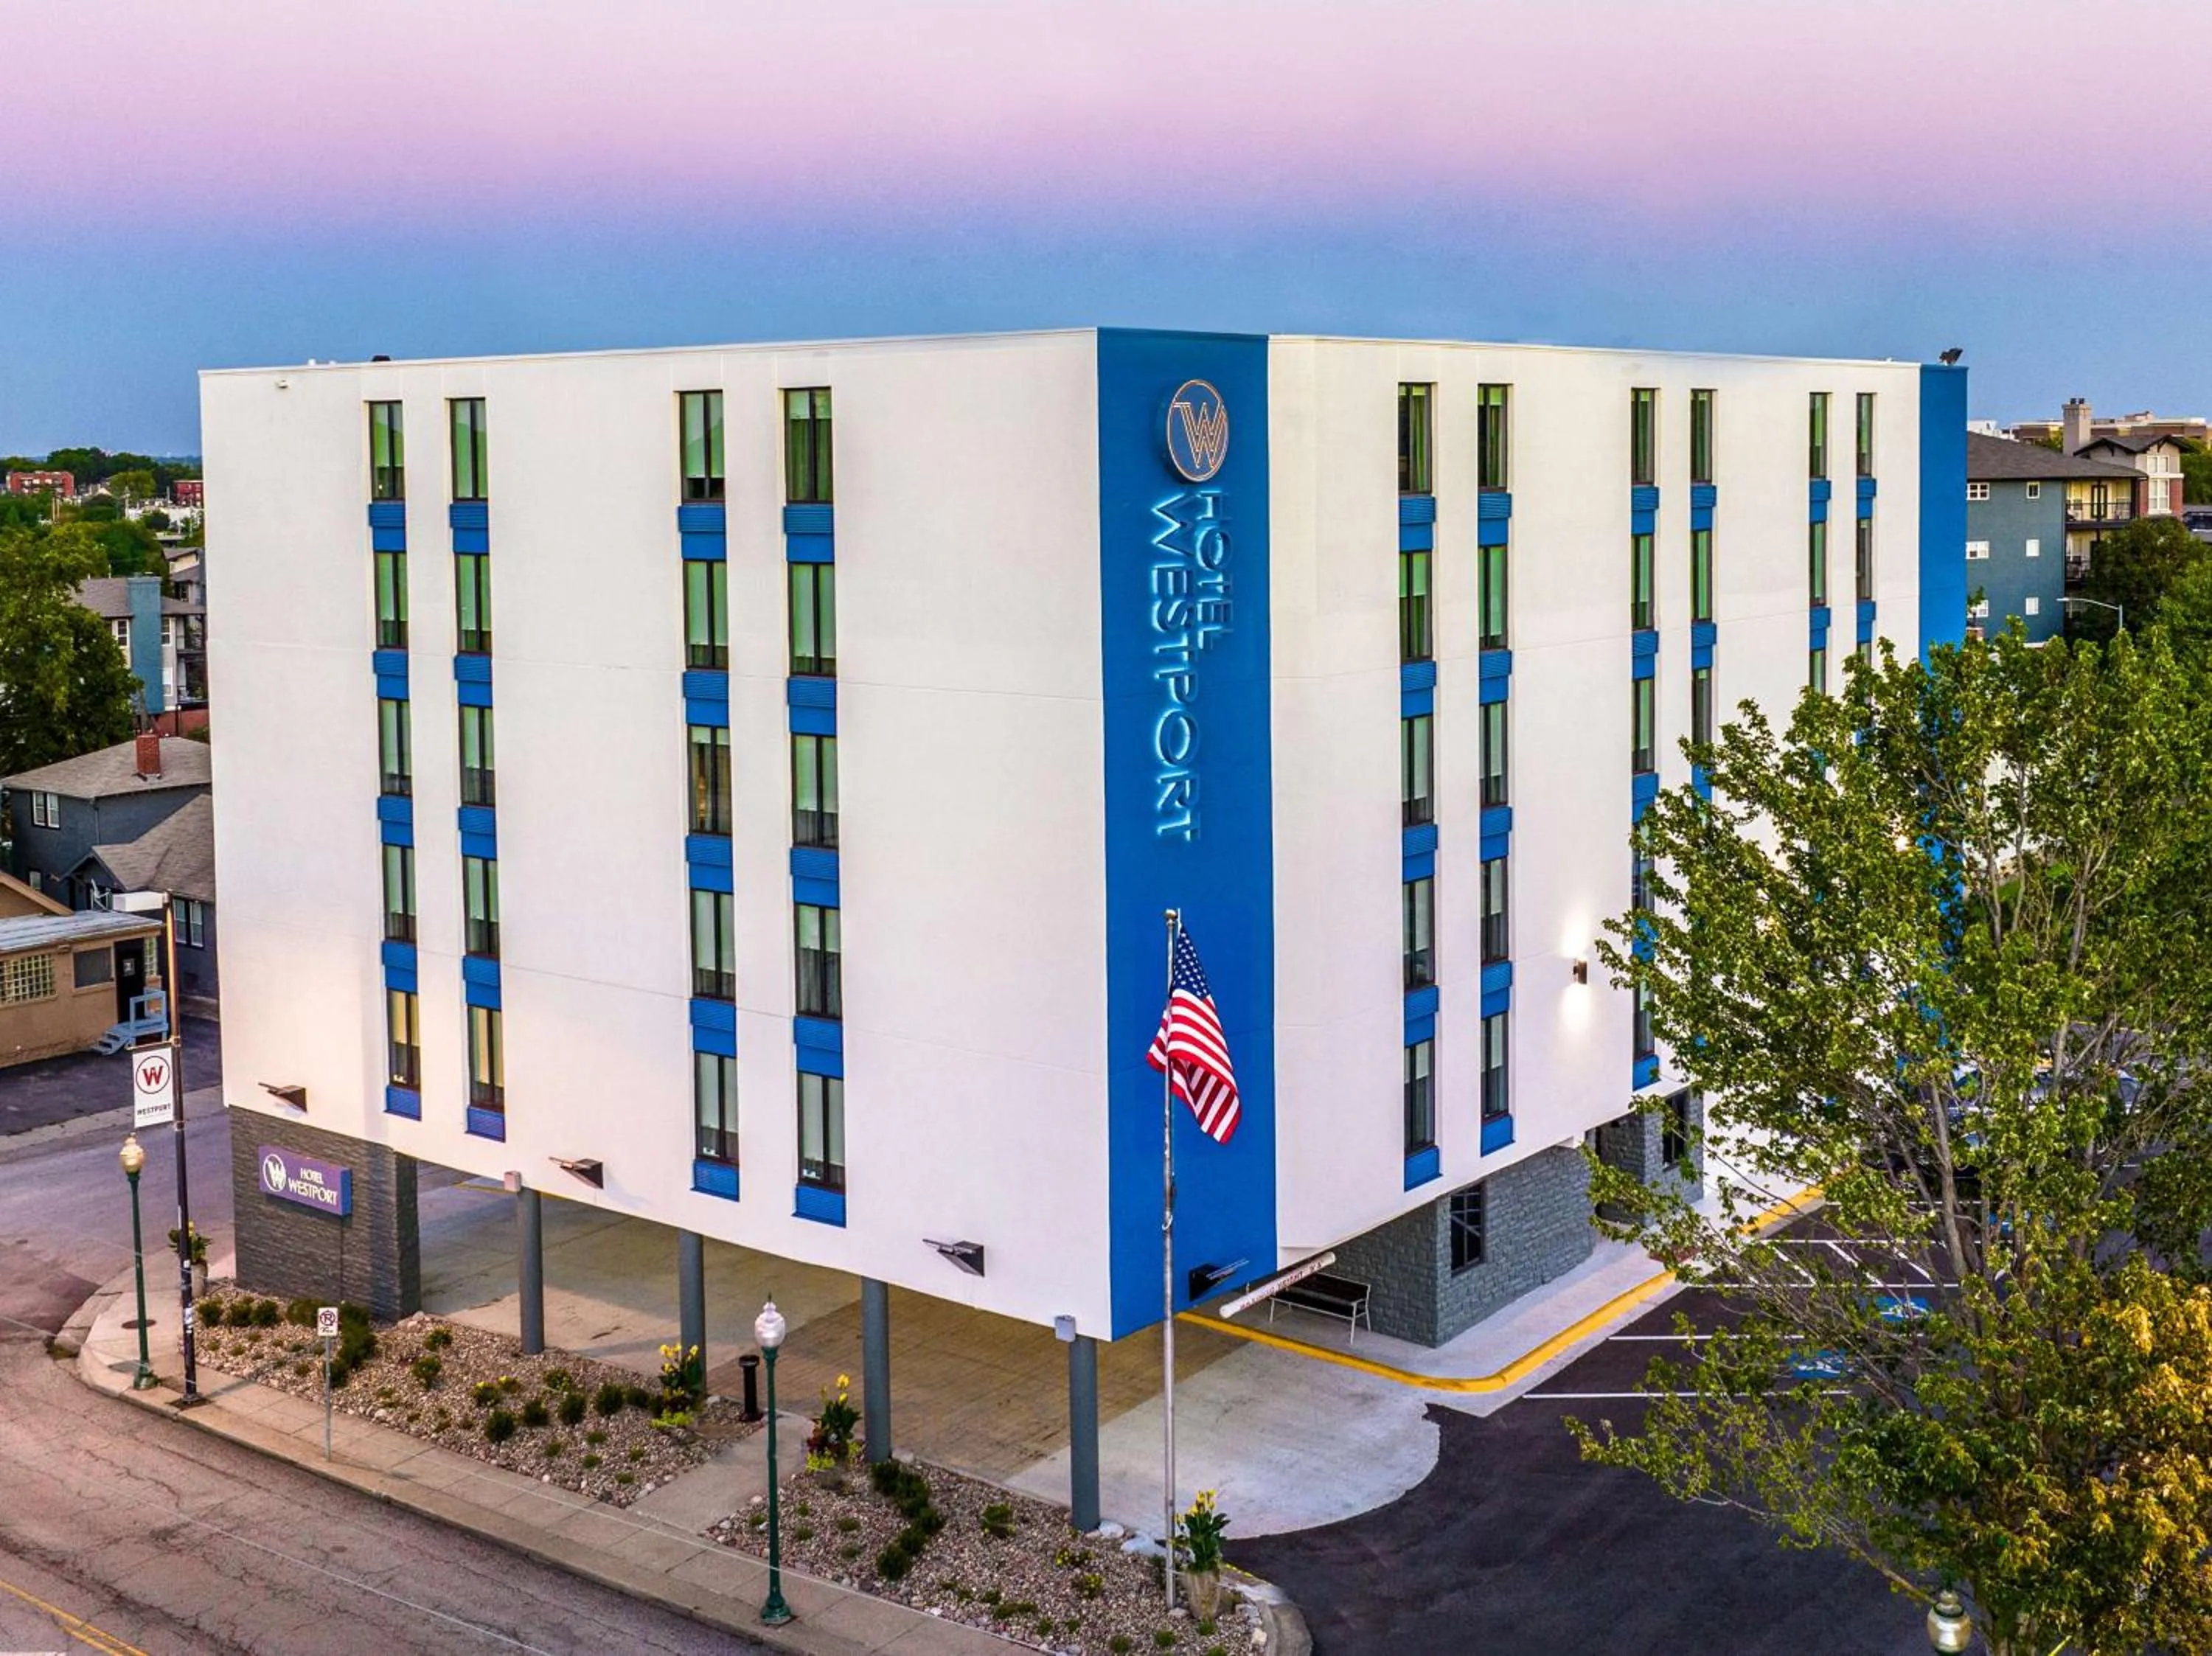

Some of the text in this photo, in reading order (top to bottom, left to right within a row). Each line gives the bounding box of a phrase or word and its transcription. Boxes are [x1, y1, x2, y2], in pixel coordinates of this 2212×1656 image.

[1195, 490, 1234, 650] HOTEL
[1151, 493, 1200, 842] WESTPORT
[142, 1065, 164, 1086] W
[267, 1160, 285, 1189] W
[300, 1168, 324, 1185] HOTEL
[288, 1177, 338, 1206] WESTPORT
